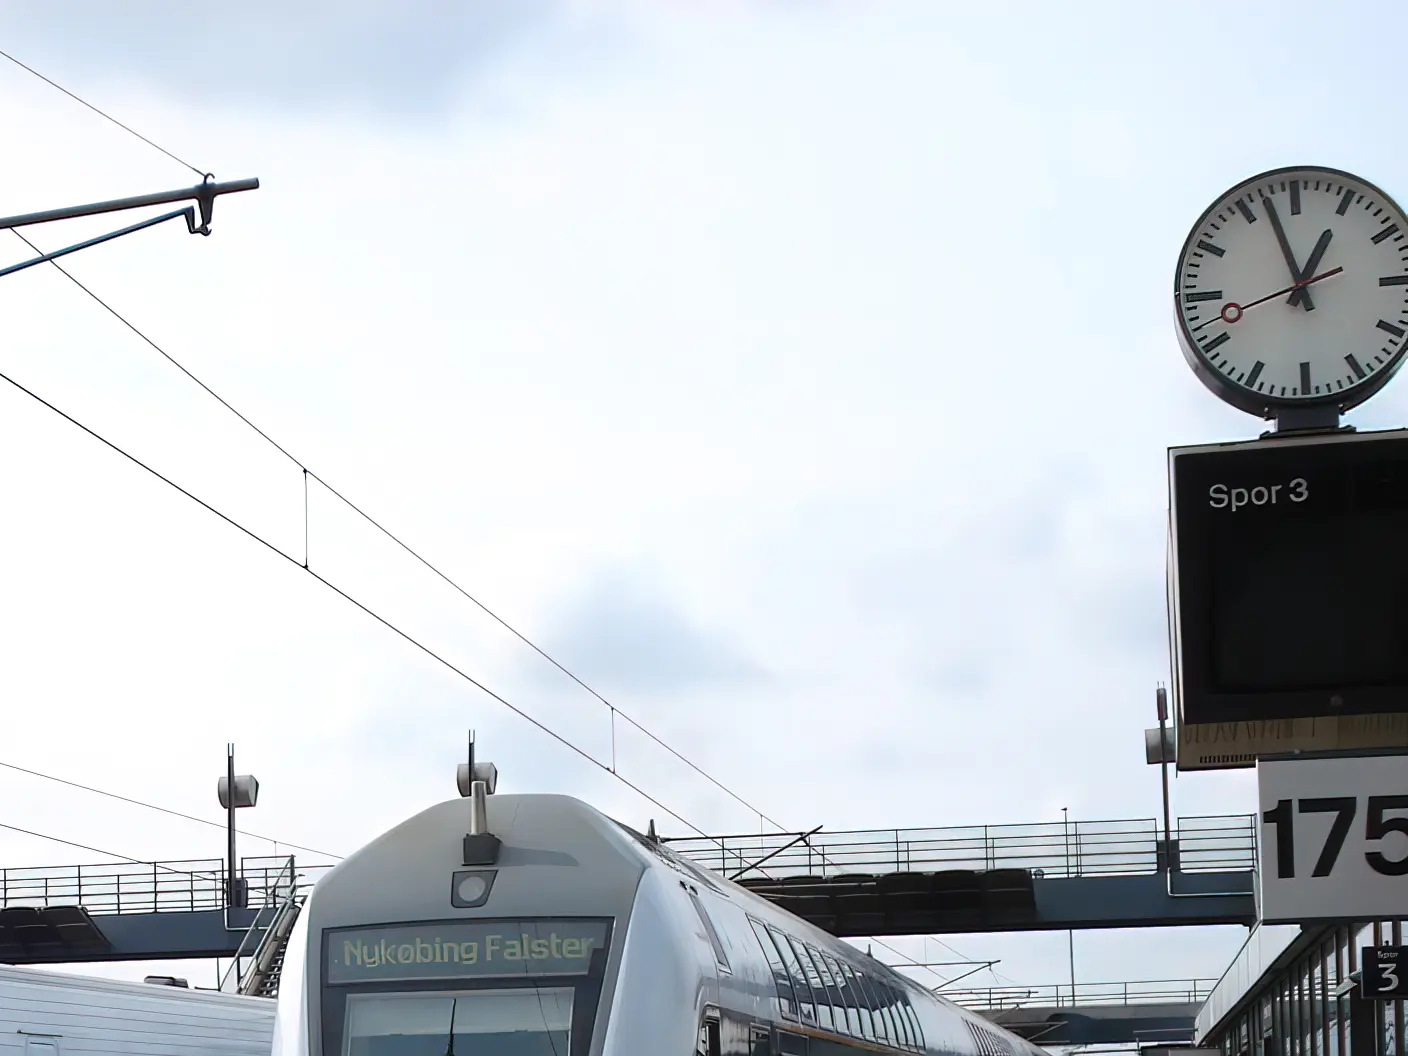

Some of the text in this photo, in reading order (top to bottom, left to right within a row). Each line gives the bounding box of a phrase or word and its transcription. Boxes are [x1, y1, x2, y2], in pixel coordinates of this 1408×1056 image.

[1208, 477, 1310, 512] Spor 3
[1263, 795, 1408, 880] 175
[485, 932, 595, 961] Falster
[1377, 963, 1399, 992] 3
